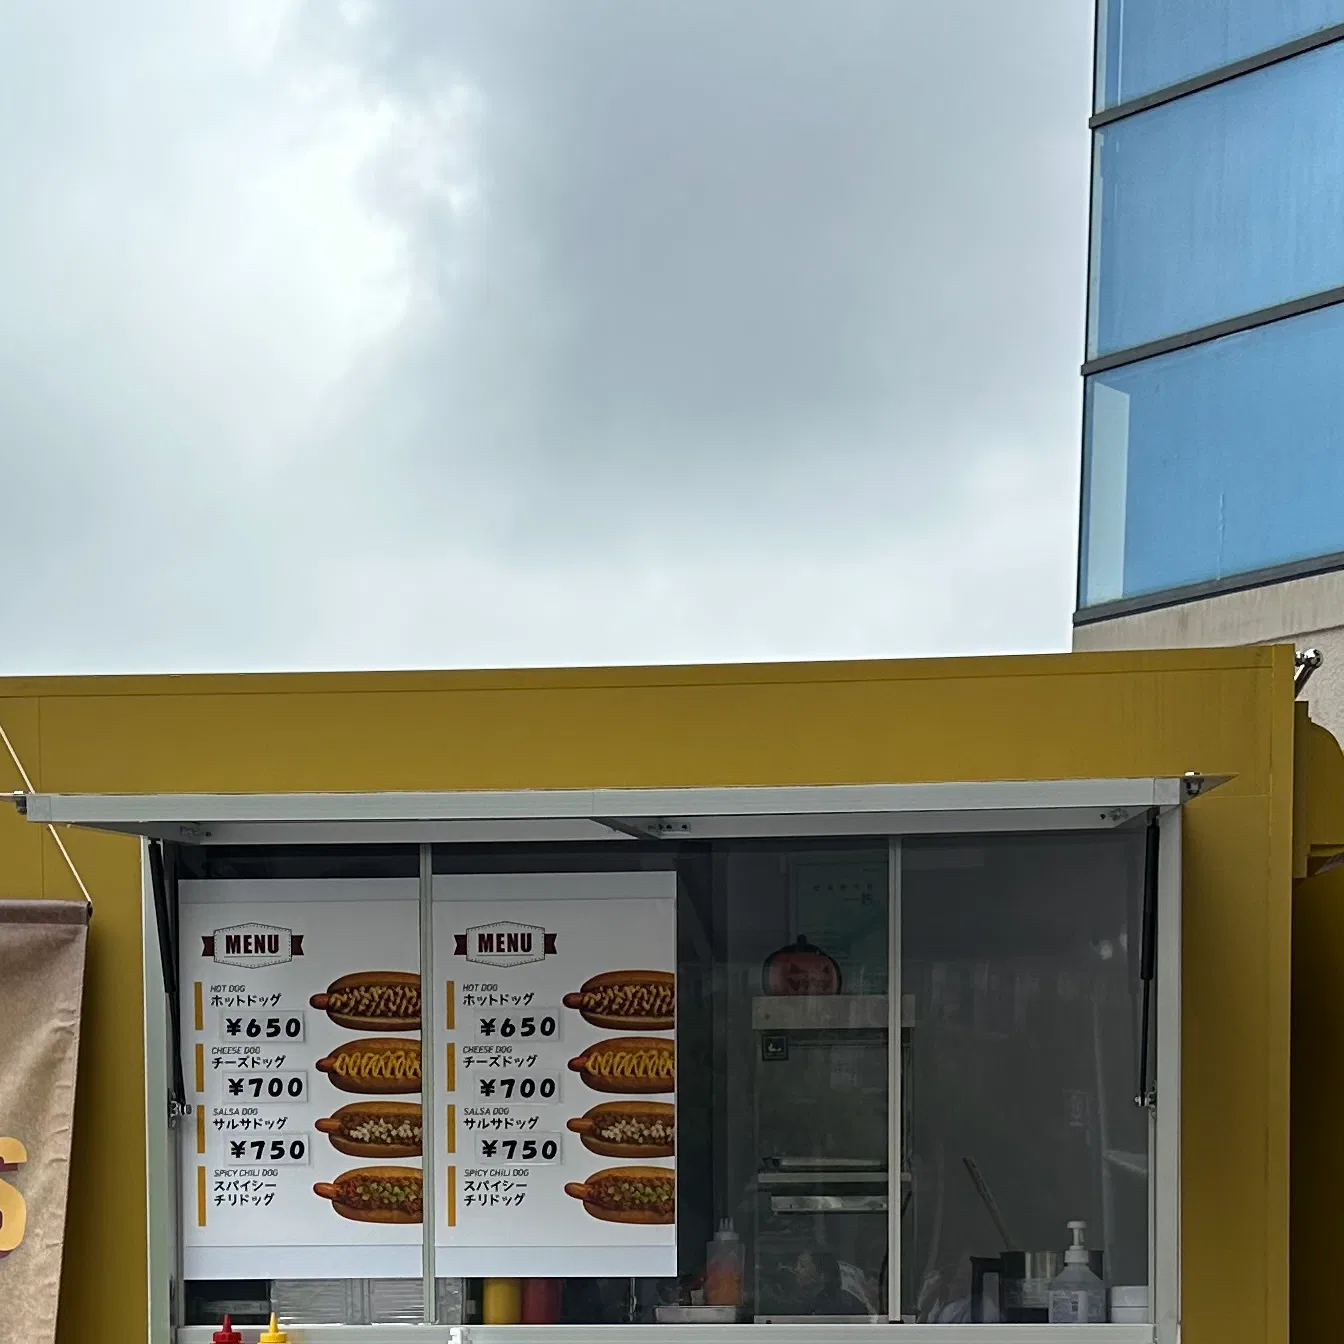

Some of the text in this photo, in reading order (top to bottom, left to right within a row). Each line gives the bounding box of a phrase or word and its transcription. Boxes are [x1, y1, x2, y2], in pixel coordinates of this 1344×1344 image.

[225, 934, 279, 954] MENU
[478, 932, 532, 953] MENU
[210, 984, 246, 992] HOT DOG
[462, 983, 498, 992] HOT DOG
[211, 992, 282, 1007] ホットドッグ
[463, 992, 535, 1006] ホットドッグ
[226, 1018, 301, 1038] ¥650
[479, 1016, 556, 1037] ¥650
[462, 1045, 513, 1054] CHEESE DOG
[211, 1055, 286, 1069] チーズドッグ
[463, 1055, 538, 1068] チーズドッグ
[227, 1077, 303, 1097] ¥700
[480, 1078, 555, 1099] ¥700
[464, 1107, 510, 1116] SALSA DOG
[213, 1117, 288, 1131] サルサドッグ
[463, 1116, 539, 1130] サルサドッグ
[230, 1140, 305, 1160] ¥750
[481, 1140, 557, 1160] ¥750
[214, 1180, 277, 1192] スパイシー
[464, 1180, 527, 1192] スパイシー
[214, 1193, 275, 1206] チリドッグ
[464, 1193, 526, 1207] チリドッグ
